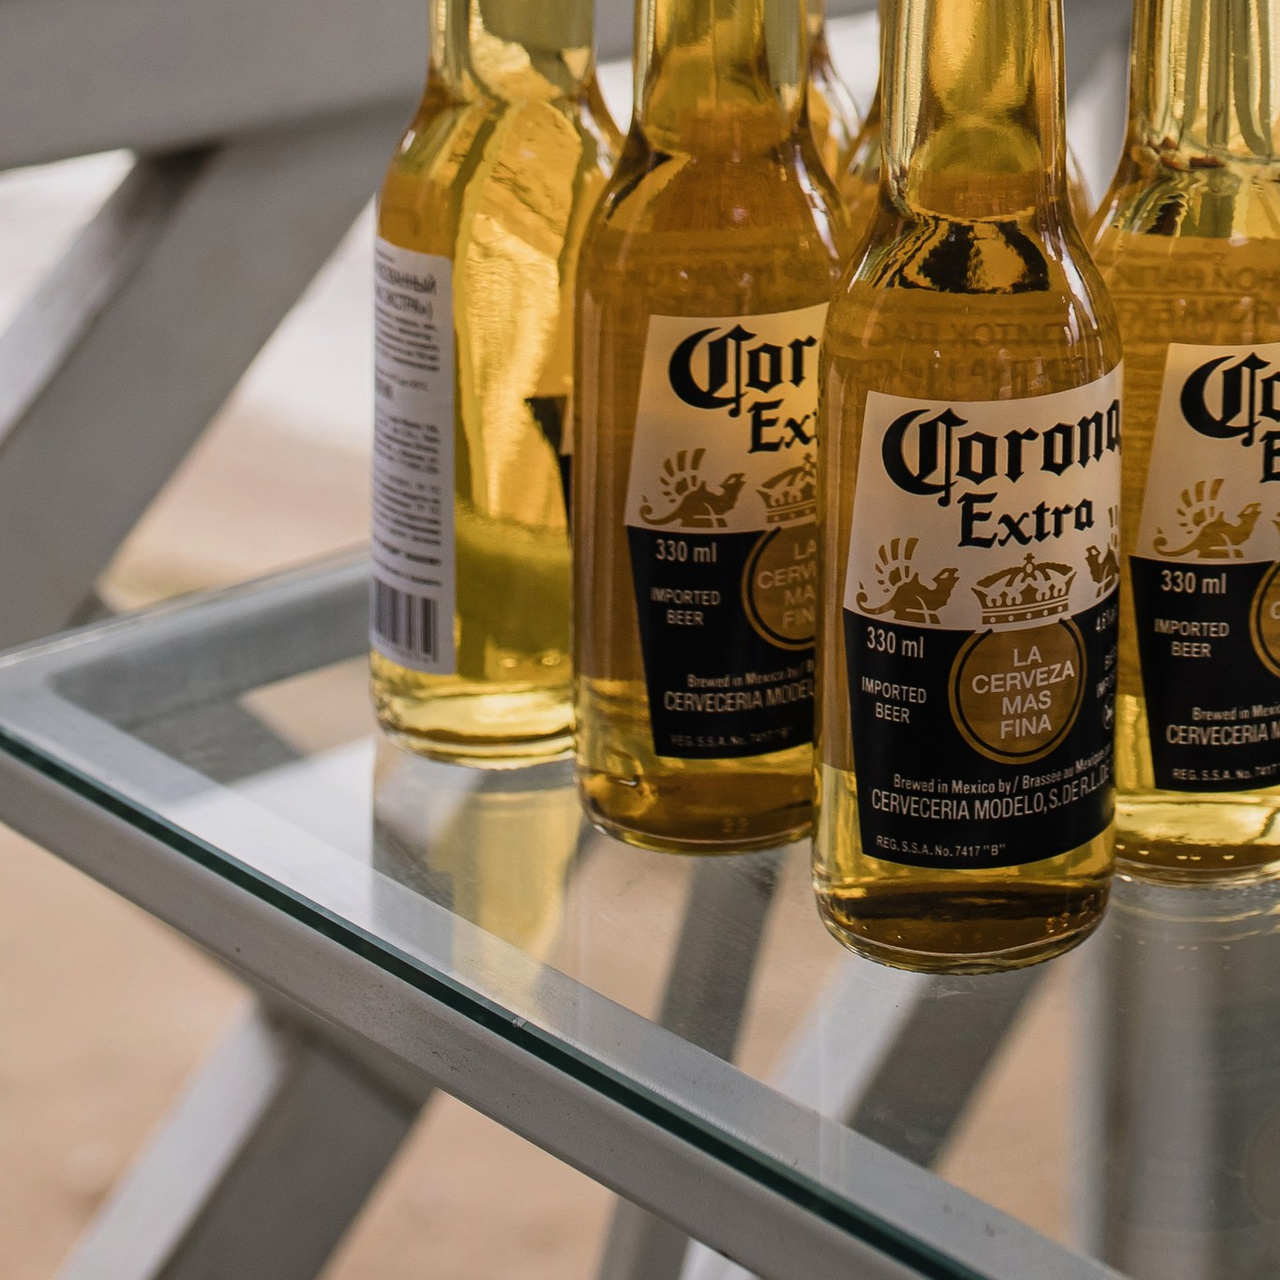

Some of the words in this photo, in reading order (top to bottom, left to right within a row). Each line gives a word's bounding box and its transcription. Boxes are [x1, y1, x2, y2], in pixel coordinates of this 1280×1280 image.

[668, 324, 817, 417] Cor
[882, 399, 1121, 507] Corona
[957, 492, 1094, 549] Extra
[656, 540, 688, 562] 330
[693, 542, 718, 563] ml
[758, 560, 816, 589] CERV
[1160, 570, 1196, 593] 330
[1201, 573, 1227, 594] ml
[650, 587, 721, 607] IMPORTED
[784, 584, 816, 607] MA
[666, 609, 704, 626] BEER
[782, 605, 816, 629] FIN
[1154, 618, 1230, 637] IMPORTED
[866, 626, 896, 654] 330
[902, 636, 924, 659] ml
[1171, 641, 1212, 658] BEER
[1013, 645, 1042, 668] LA
[972, 659, 1075, 694] CERVEZA
[664, 690, 763, 713] CERVECERIA
[765, 679, 816, 707] MODEL
[861, 675, 927, 704] IMPORTED
[875, 702, 910, 724] BEER
[1002, 690, 1052, 716] MAS
[1192, 707, 1237, 721] Brewed
[1239, 706, 1250, 719] in
[1000, 713, 1052, 739] FINA
[1166, 724, 1269, 745] CERVECERIA
[893, 773, 934, 793] Brewed
[937, 777, 948, 794] in
[951, 780, 995, 794] Mexico
[998, 778, 1012, 795] by
[871, 788, 970, 820] CERVECERIA
[974, 792, 1048, 820] MODELO,
[876, 835, 900, 850] REG.
[935, 842, 953, 857] No.
[955, 844, 981, 857] 7417
